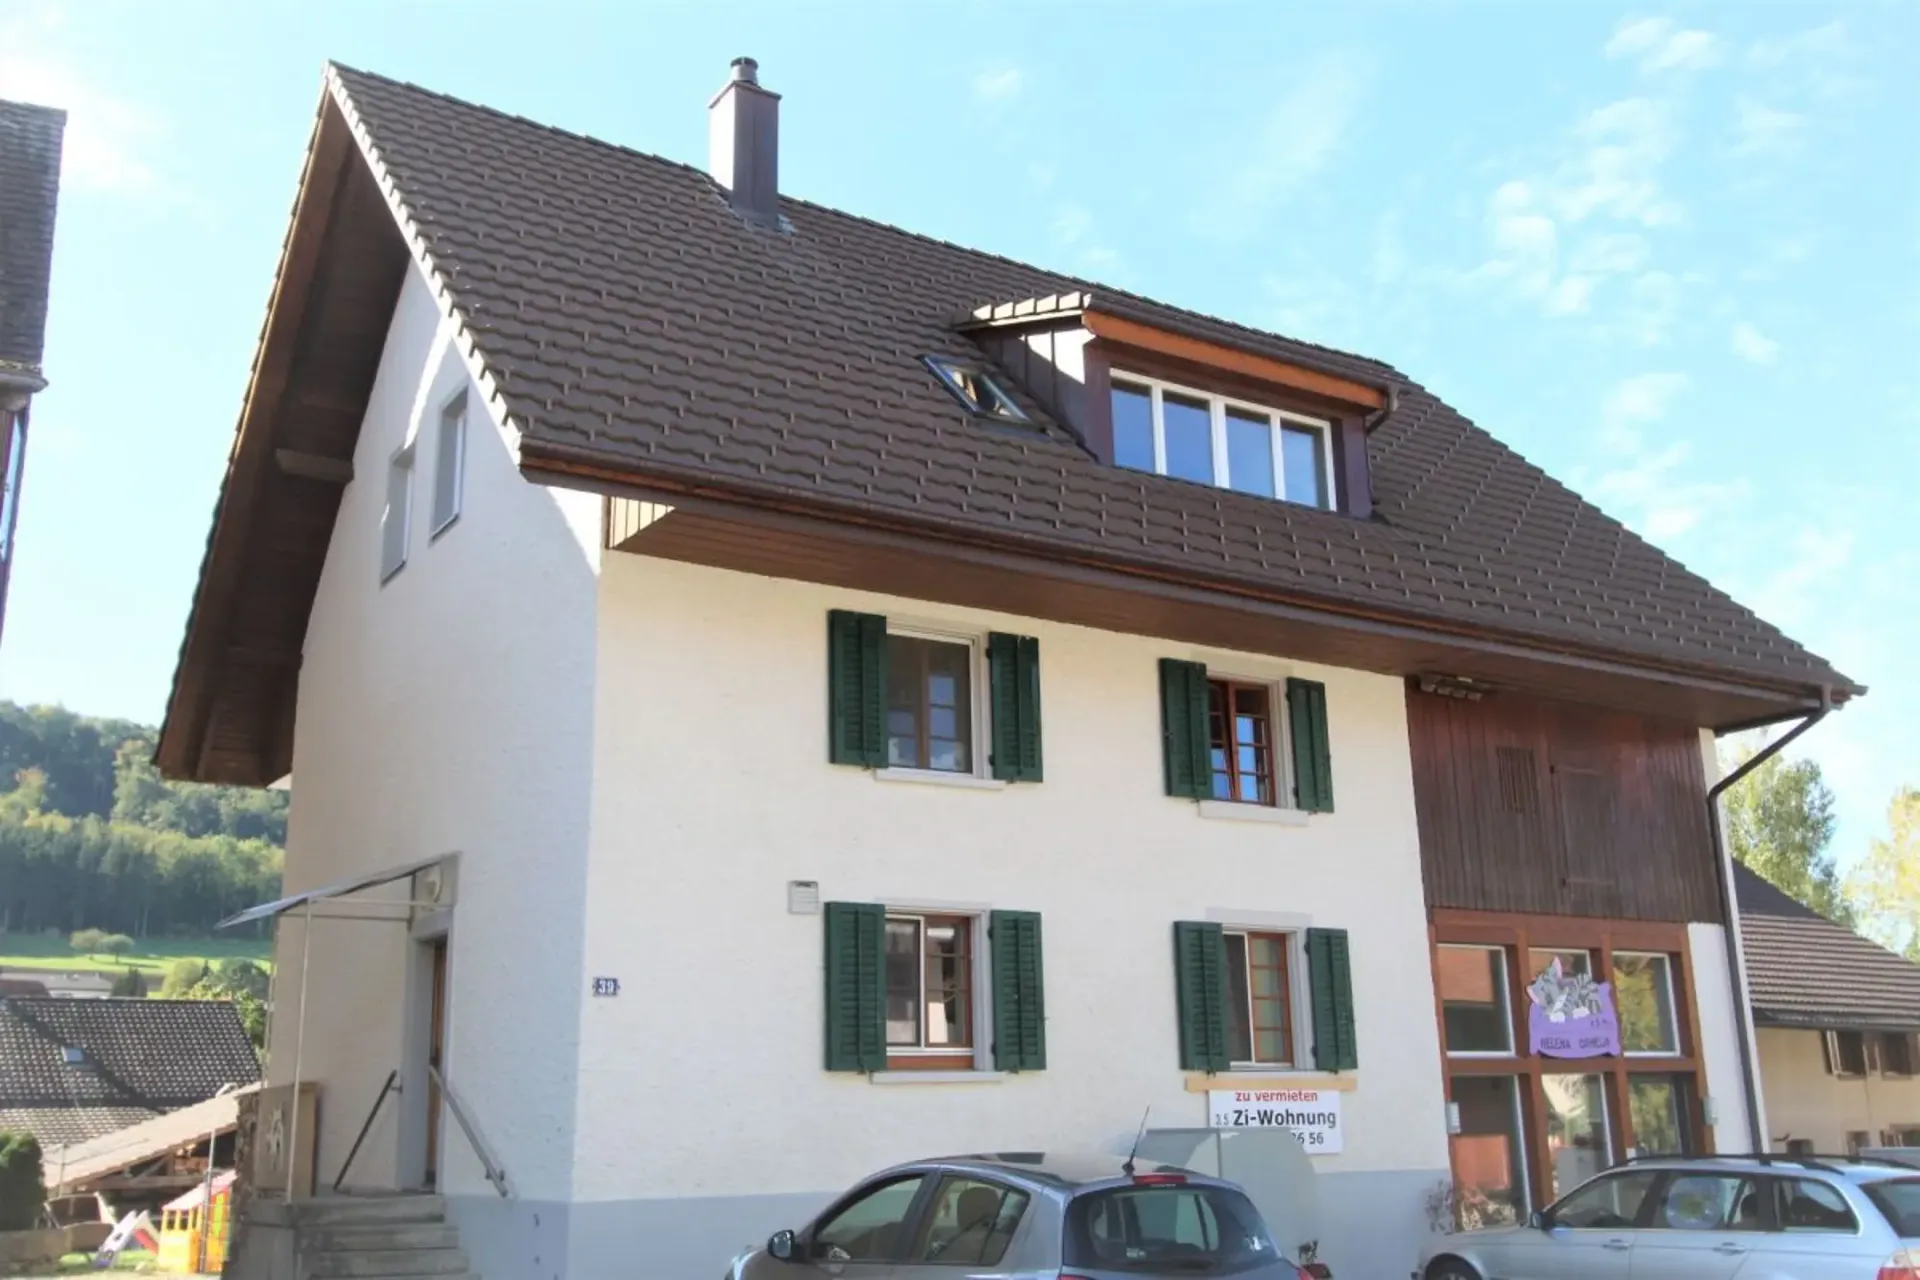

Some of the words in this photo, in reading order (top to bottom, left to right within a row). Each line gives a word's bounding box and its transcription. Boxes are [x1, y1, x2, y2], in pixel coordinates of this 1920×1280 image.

[1235, 1092, 1250, 1102] zu
[1254, 1089, 1318, 1102] vermieten
[1232, 1108, 1336, 1128] Zi-Wohnung
[1309, 1132, 1324, 1145] 56
